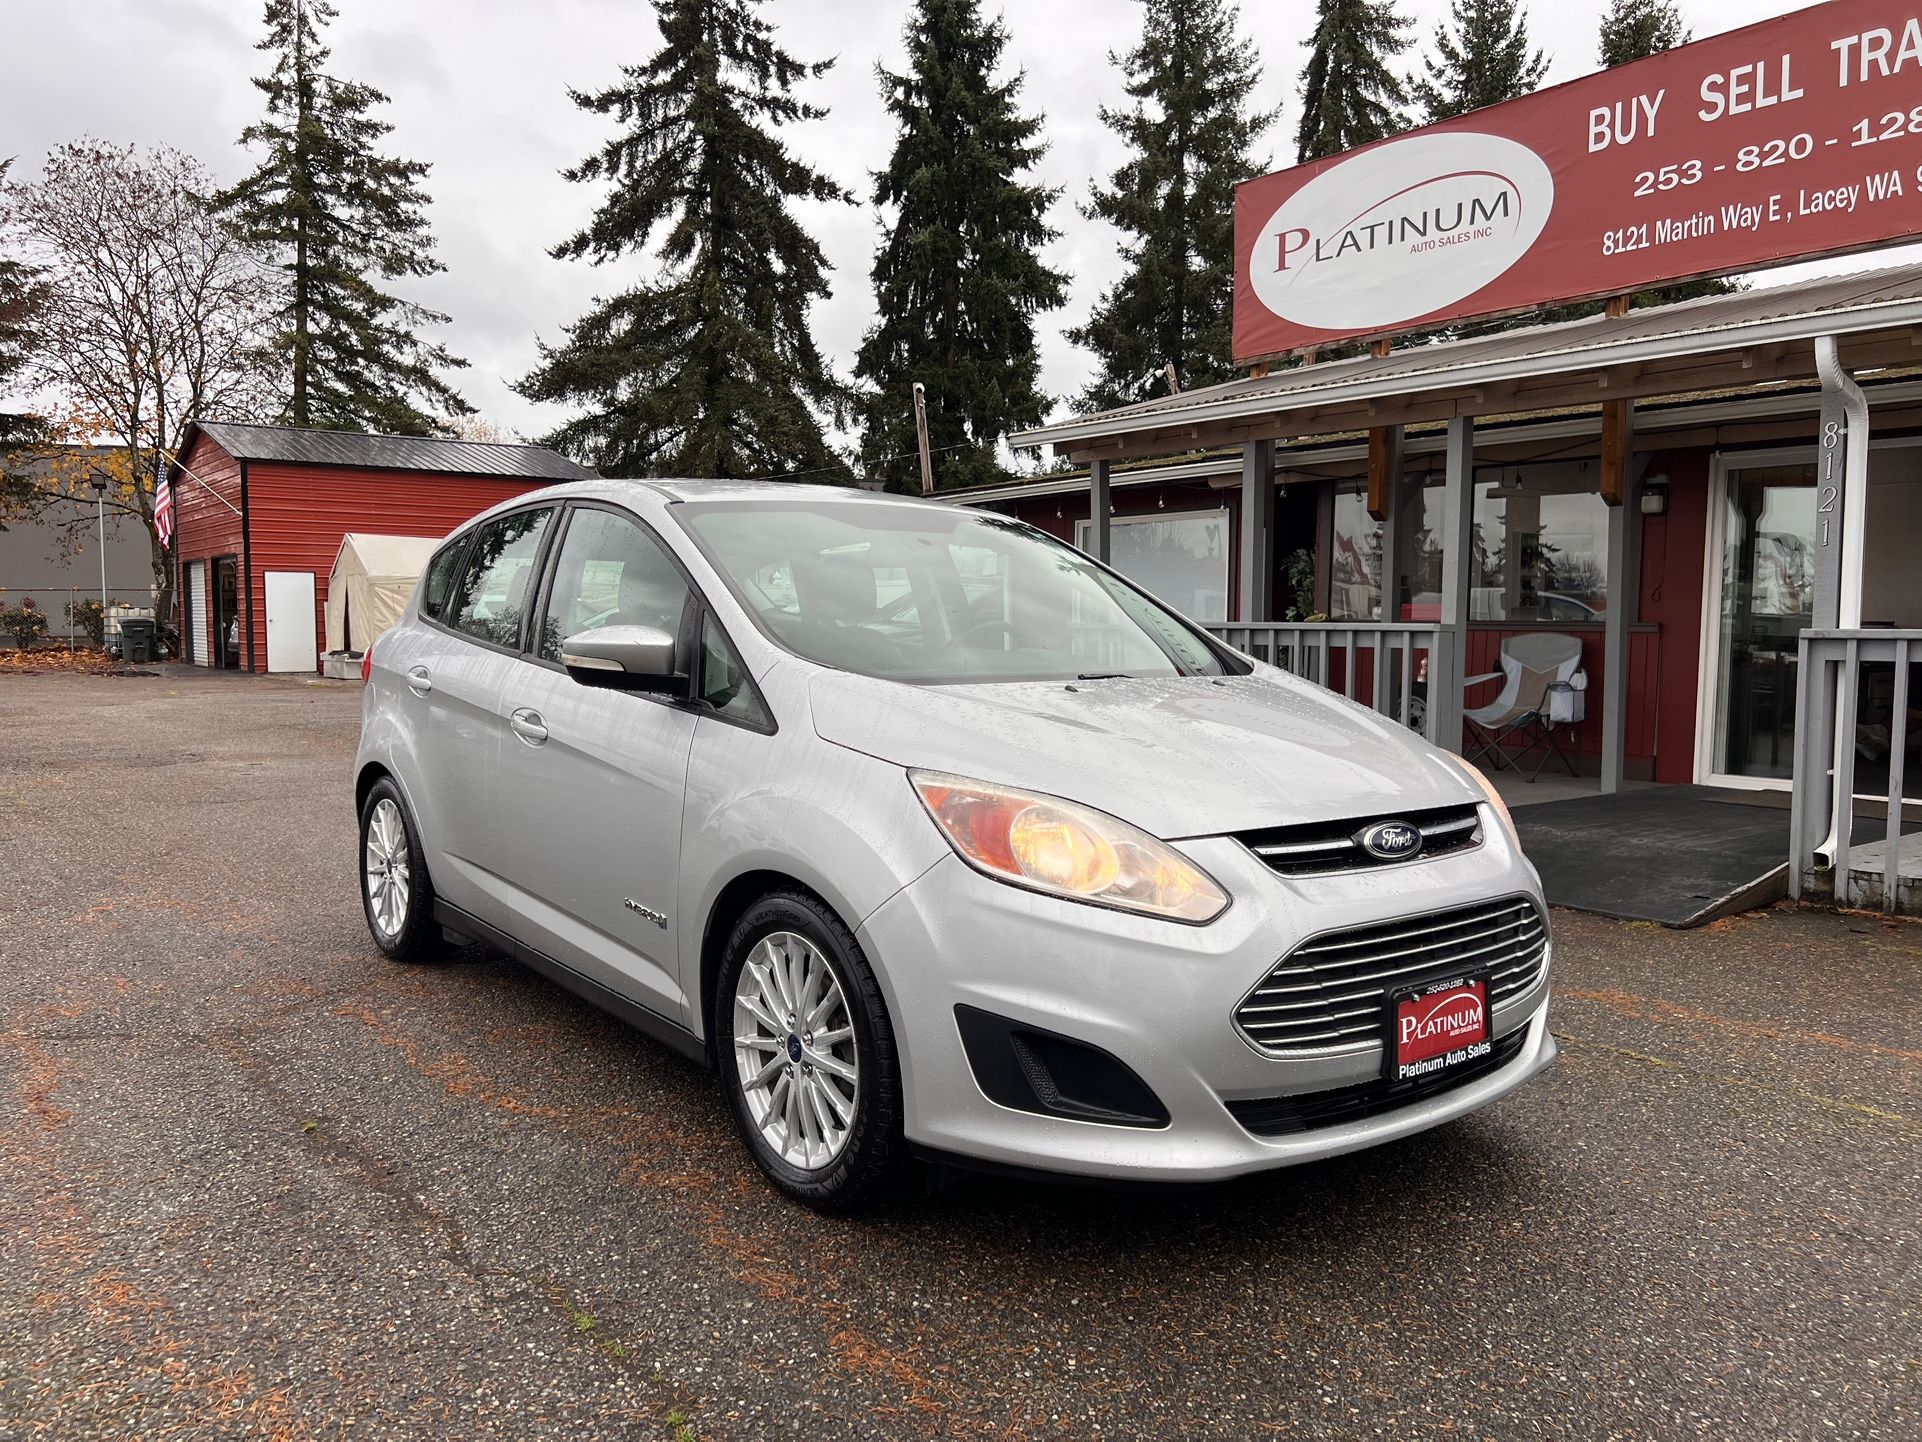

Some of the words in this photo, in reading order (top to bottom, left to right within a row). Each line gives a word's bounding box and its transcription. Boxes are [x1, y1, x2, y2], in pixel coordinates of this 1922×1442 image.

[1588, 88, 1665, 153] BUY
[1698, 53, 1803, 122] SELL
[1830, 18, 1922, 88] TRA
[1633, 159, 1703, 198] 253
[1735, 133, 1814, 172] 820
[1273, 190, 1510, 274] PLATINUM
[1409, 240, 1436, 254] AUTO
[1438, 233, 1471, 247] SALES
[1473, 226, 1492, 240] INC
[1602, 223, 1650, 256] 8121
[1655, 211, 1715, 245] Martin
[1721, 203, 1763, 231] Way
[1799, 184, 1860, 216] Lacey
[1865, 169, 1903, 202] WA
[1818, 421, 1839, 547] 8121
[1382, 828, 1413, 850] Ford
[1400, 1007, 1482, 1044] PLATINUM
[1399, 1058, 1444, 1079] Platinum
[1445, 1051, 1466, 1067] Auto
[1467, 1041, 1491, 1059] Sales
